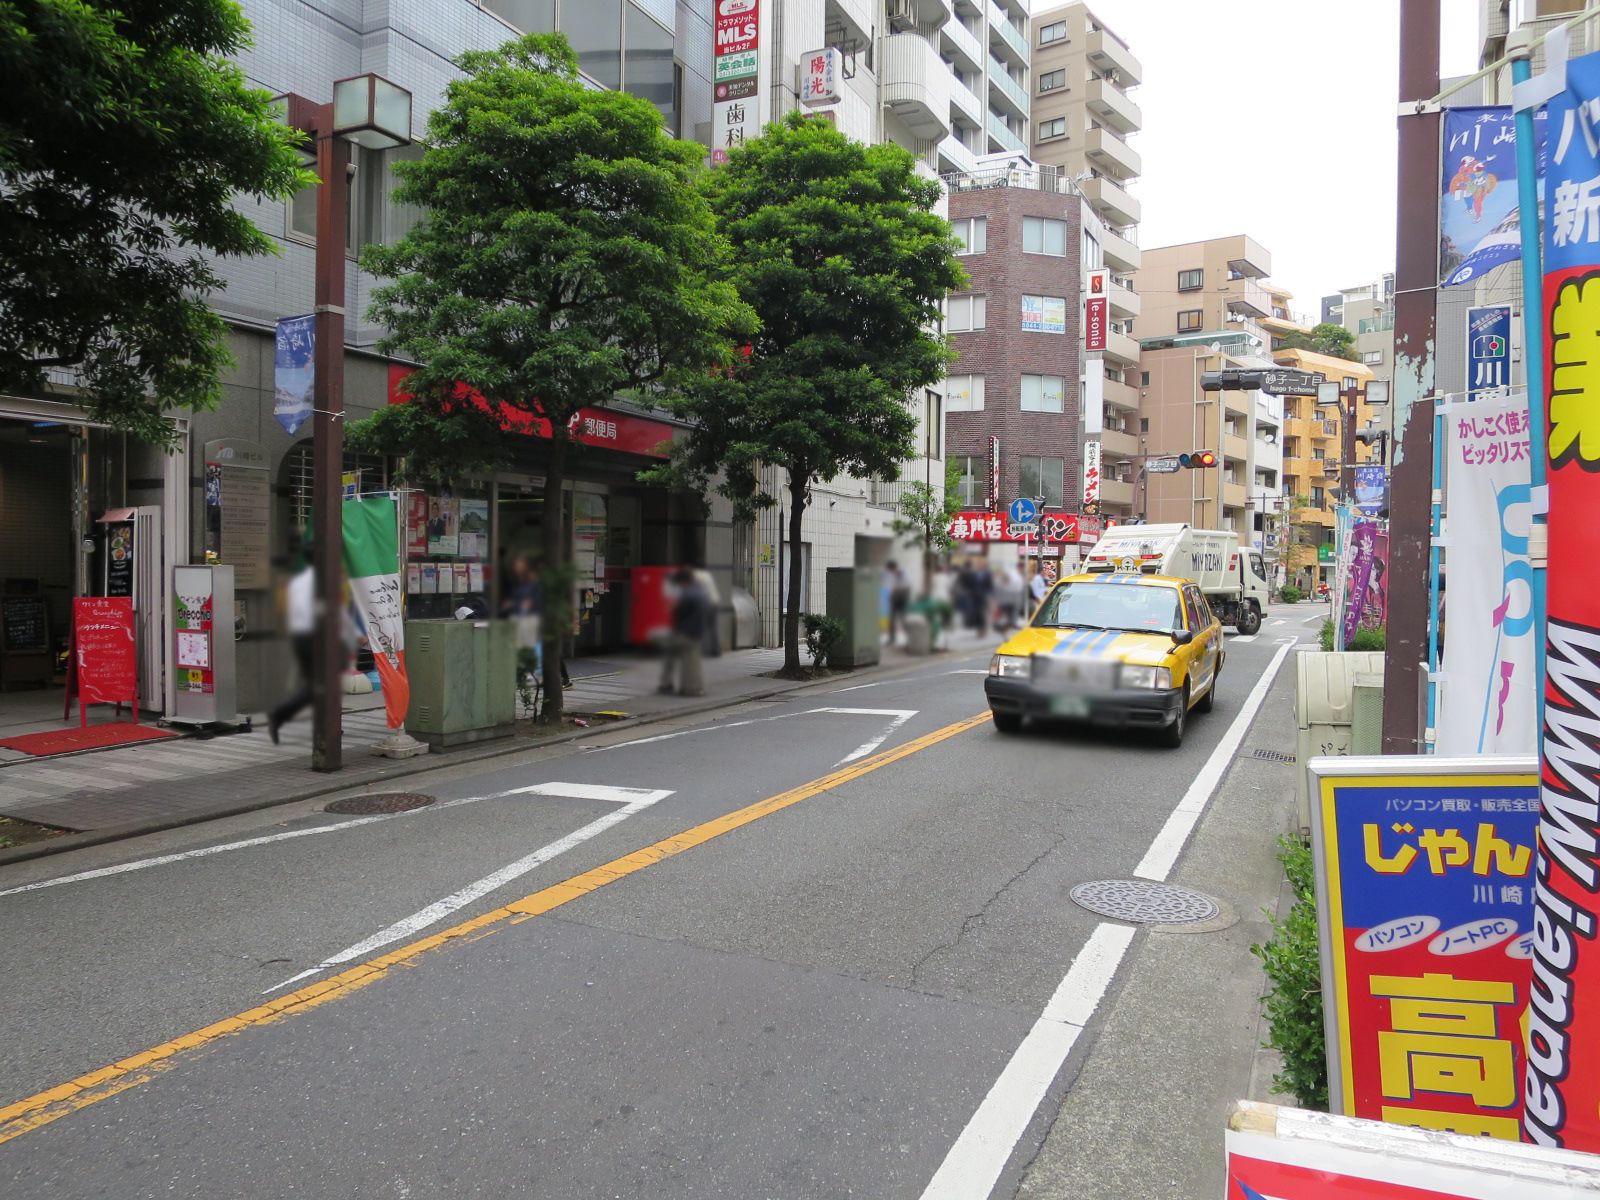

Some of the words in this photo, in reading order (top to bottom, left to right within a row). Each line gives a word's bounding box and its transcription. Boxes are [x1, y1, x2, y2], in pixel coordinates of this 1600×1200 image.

[717, 23, 757, 46] MLS
[810, 56, 825, 94] 陽光
[727, 103, 746, 147] 歯科
[1090, 301, 1104, 347] le-sonia
[1265, 373, 1323, 387] 砂子一丁目
[584, 417, 617, 440] 郵便局
[1362, 822, 1540, 877] じゃん
[1473, 884, 1536, 905] 川崎
[1367, 920, 1425, 948] パソコン
[1441, 920, 1509, 953] ノートPC
